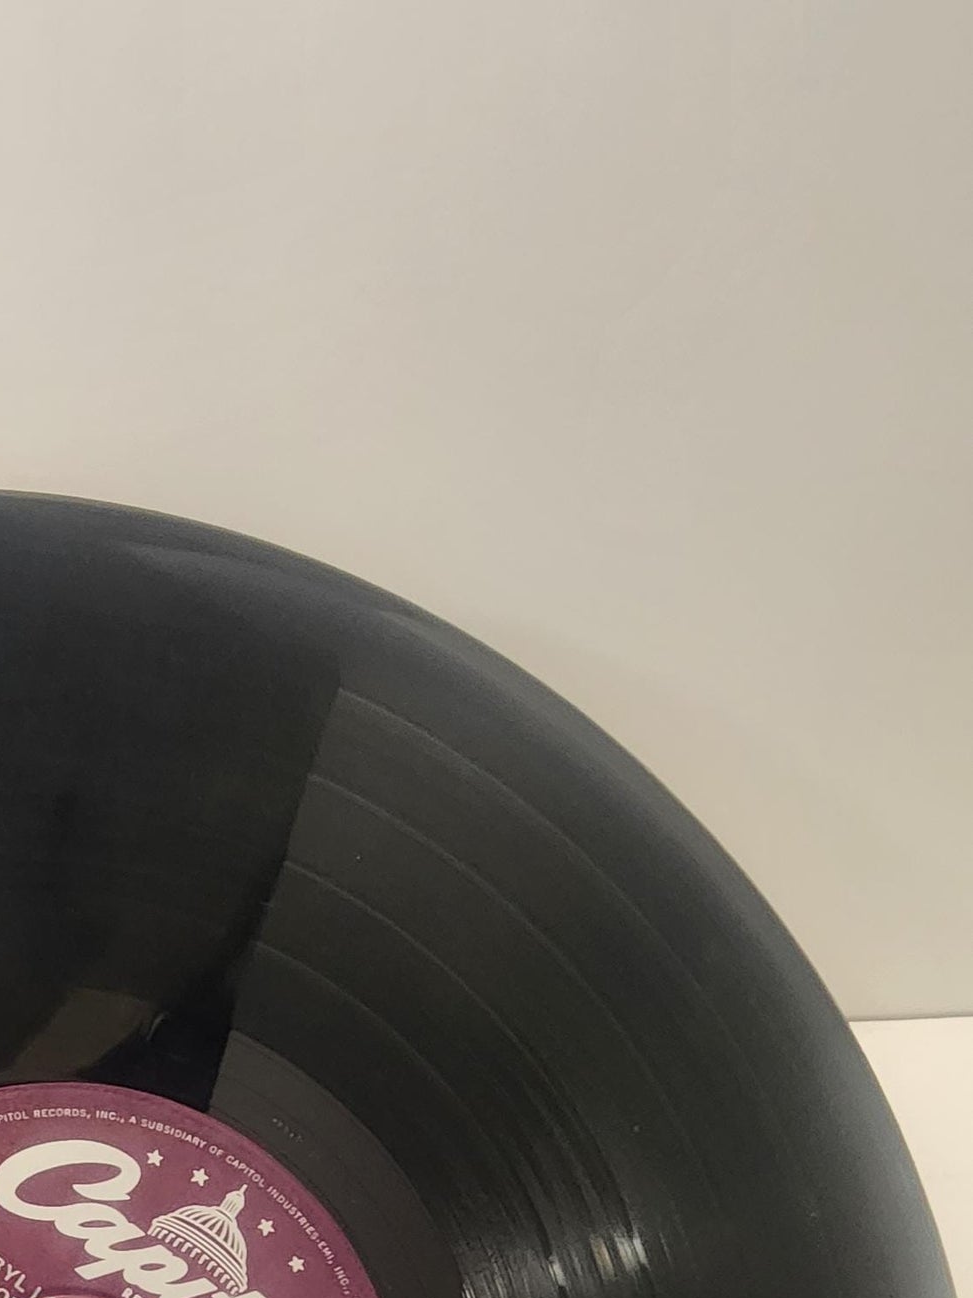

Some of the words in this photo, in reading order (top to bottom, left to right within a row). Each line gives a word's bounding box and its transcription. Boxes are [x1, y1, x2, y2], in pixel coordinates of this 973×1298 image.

[33, 1108, 91, 1119] RECORDS,
[129, 1115, 137, 1124] A
[141, 1118, 207, 1148] SUBSIDIARY
[209, 1146, 224, 1157] OF
[226, 1155, 265, 1187] CAPITOL
